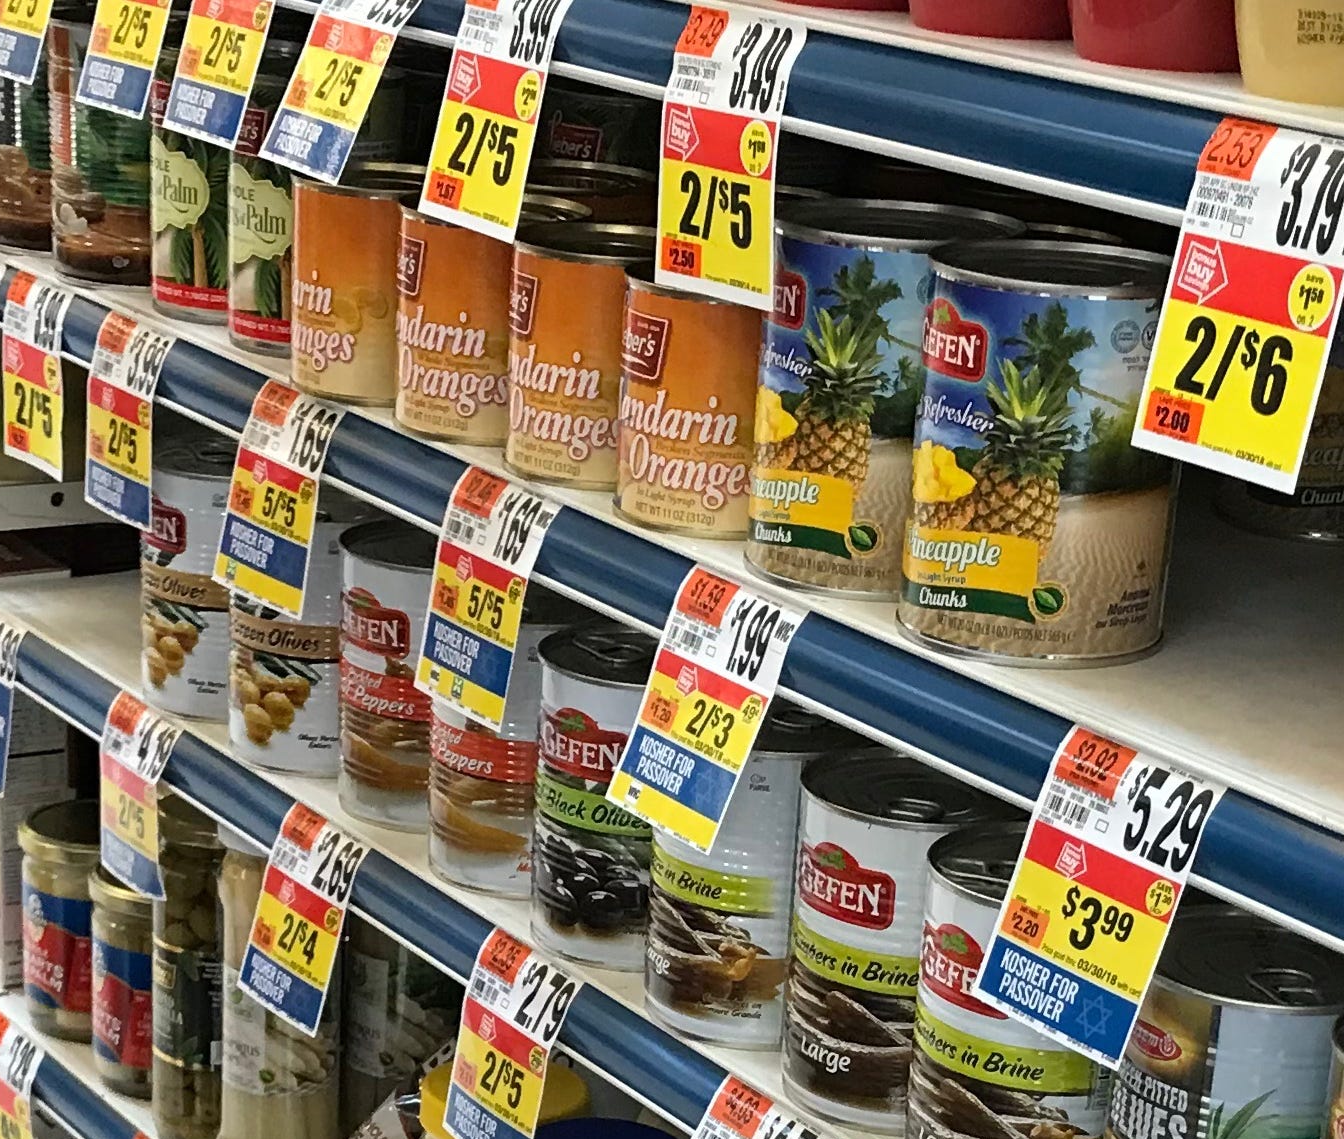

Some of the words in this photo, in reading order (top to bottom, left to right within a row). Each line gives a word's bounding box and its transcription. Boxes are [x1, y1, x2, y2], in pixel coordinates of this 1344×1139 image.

[114, 3, 151, 49] 2/$5
[203, 26, 244, 74] 2/$5
[728, 19, 795, 114] $3.49
[314, 58, 363, 107] 2/$5
[447, 111, 518, 188] 2/$5
[163, 173, 198, 207] Palm
[679, 170, 753, 250] 2/$5
[246, 205, 287, 240] Palm
[923, 318, 978, 370] GEFEN
[1174, 315, 1294, 416] 2/$6
[923, 395, 995, 435] Refresher
[1155, 404, 1191, 434] $2.00
[108, 418, 138, 465] 2/$5
[261, 488, 298, 527] 5/$5
[494, 491, 543, 567] $1.69
[755, 522, 793, 544] Chunks
[467, 584, 504, 633] 5/$5
[919, 586, 967, 609] Chunks
[267, 627, 322, 654] Olives
[433, 639, 472, 678] PASSOVER
[726, 598, 783, 683] $1.99
[350, 685, 416, 717] Peppers
[685, 698, 736, 749] 2/$3
[635, 757, 683, 796] PASSOVER
[639, 734, 675, 769] KOSHER
[671, 752, 696, 779] FOR
[547, 789, 587, 822] Black
[590, 803, 652, 831] Olives
[1122, 764, 1215, 875] $5.29
[313, 831, 364, 904] $2.69
[677, 872, 724, 900] Brine
[799, 867, 882, 916] GEFEN
[281, 912, 318, 966] 2/$4
[1011, 912, 1039, 938] $2.20
[841, 956, 857, 976] in
[861, 961, 920, 991] Brine
[1001, 947, 1051, 990] KOSHER
[1051, 974, 1080, 1005] FOR
[1076, 957, 1119, 987] 03/30/18
[513, 957, 578, 1044] $2.79
[999, 974, 1066, 1023] PASSOVER
[801, 1033, 852, 1074] Large
[961, 1041, 979, 1067] in
[982, 1054, 1045, 1083] Brine
[481, 1051, 524, 1110] 2/$5
[1141, 1073, 1189, 1114] PITTED
